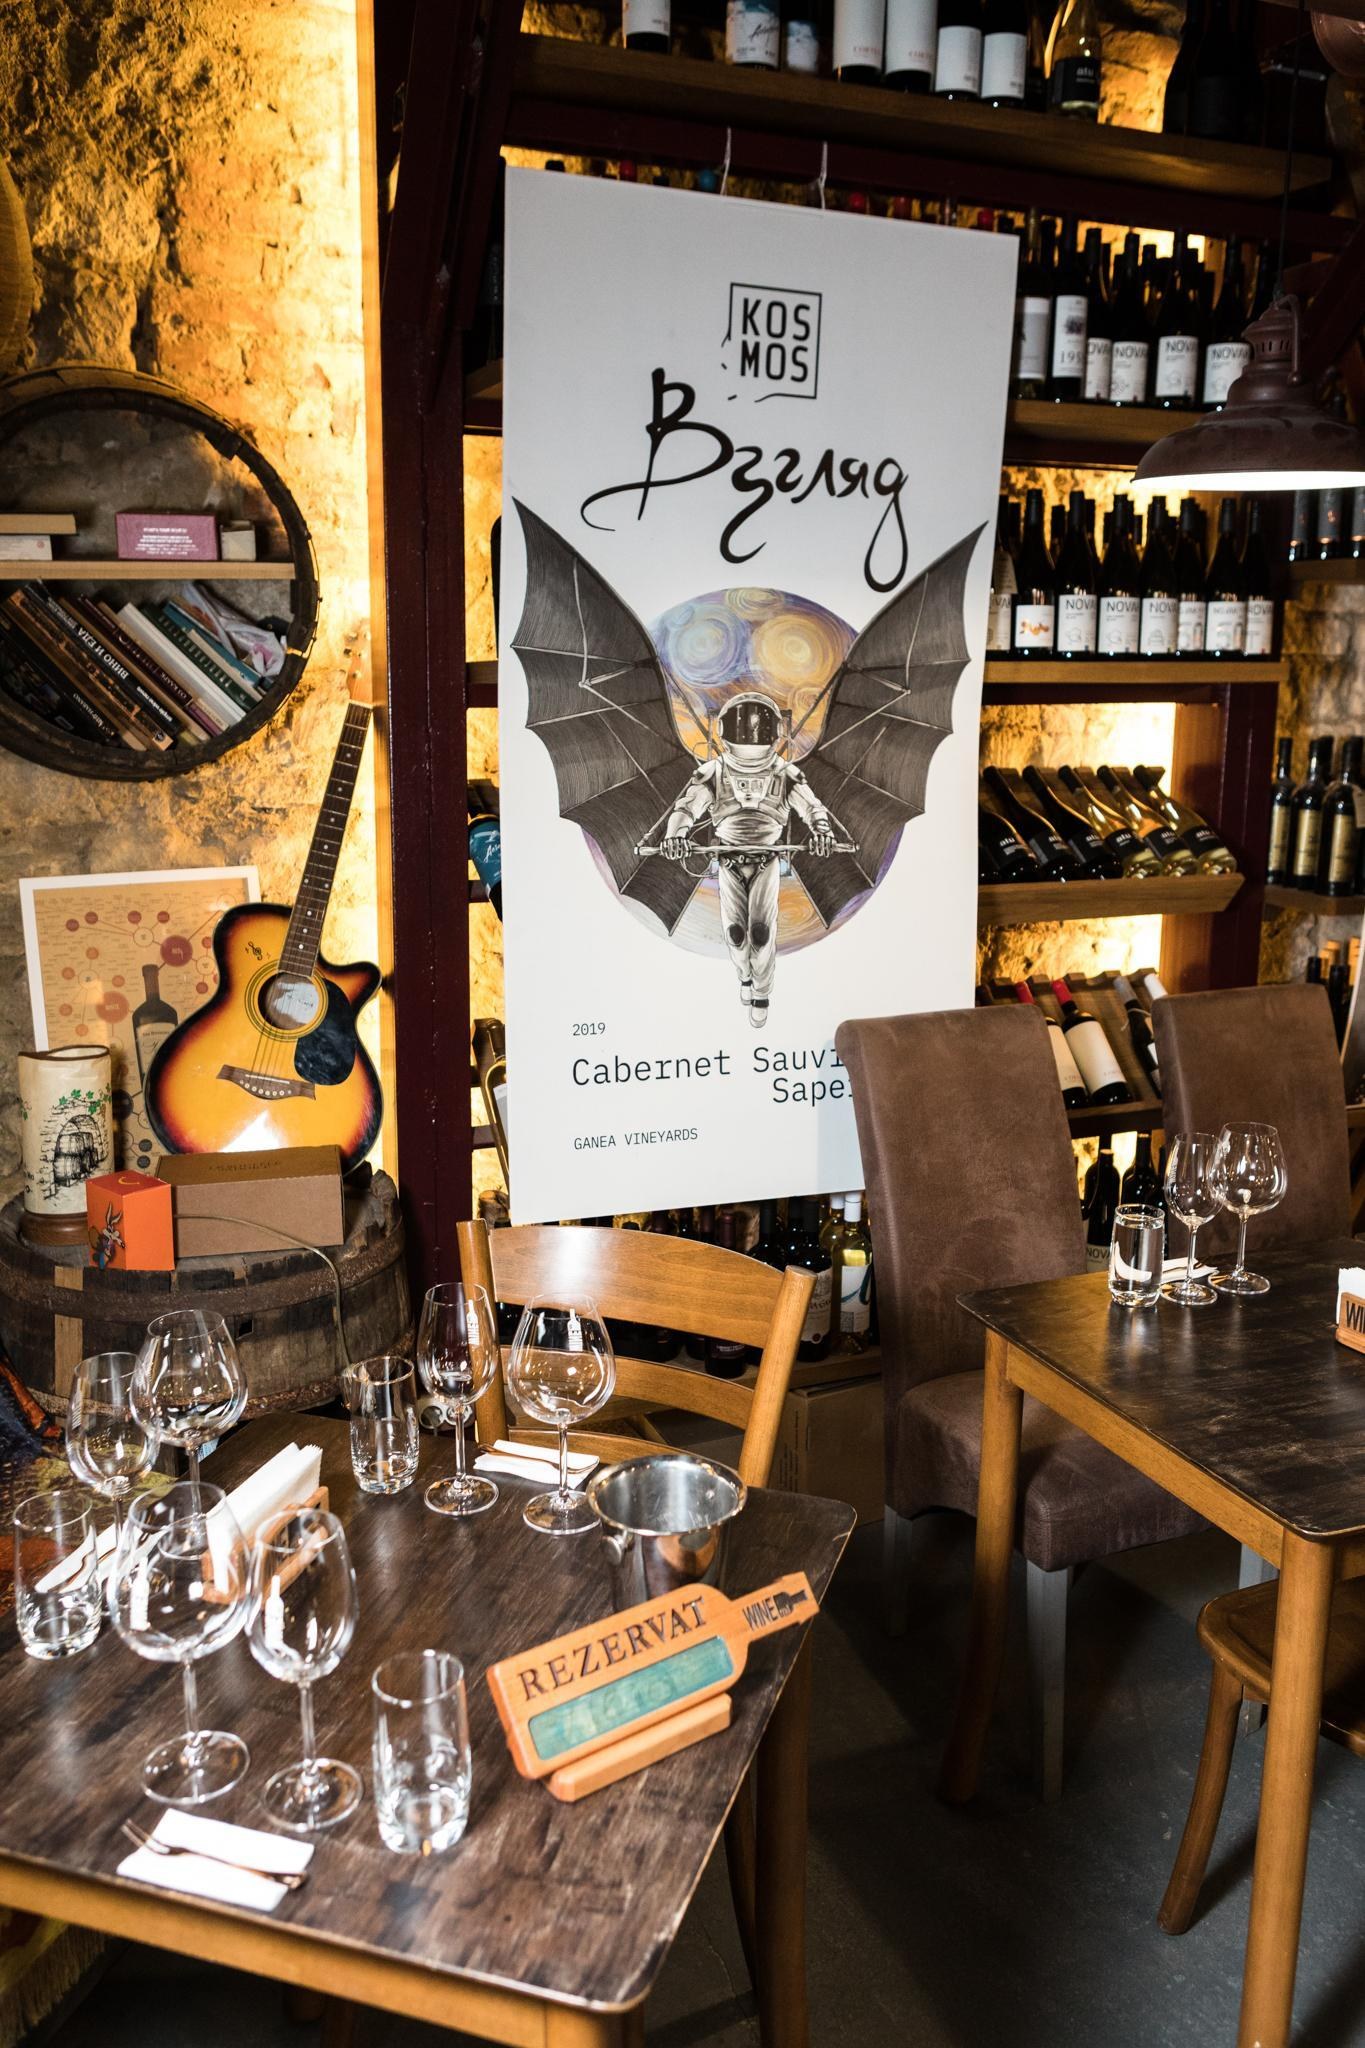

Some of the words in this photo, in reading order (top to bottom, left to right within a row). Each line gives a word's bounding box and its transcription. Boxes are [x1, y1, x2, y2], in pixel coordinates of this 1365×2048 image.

[741, 297, 812, 342] KOS
[739, 339, 809, 383] MOS
[78, 627, 97, 648] ЕДА
[94, 645, 105, 656] И
[103, 653, 130, 680] ВИНО
[572, 1022, 606, 1036] 2019
[572, 1050, 731, 1086] Cabernet
[772, 1077, 853, 1107] Sape
[573, 1135, 617, 1151] GANEA
[624, 1127, 699, 1146] VINEYARDS
[742, 1597, 778, 1632] WINE
[517, 1595, 707, 1702] REZERVAT
